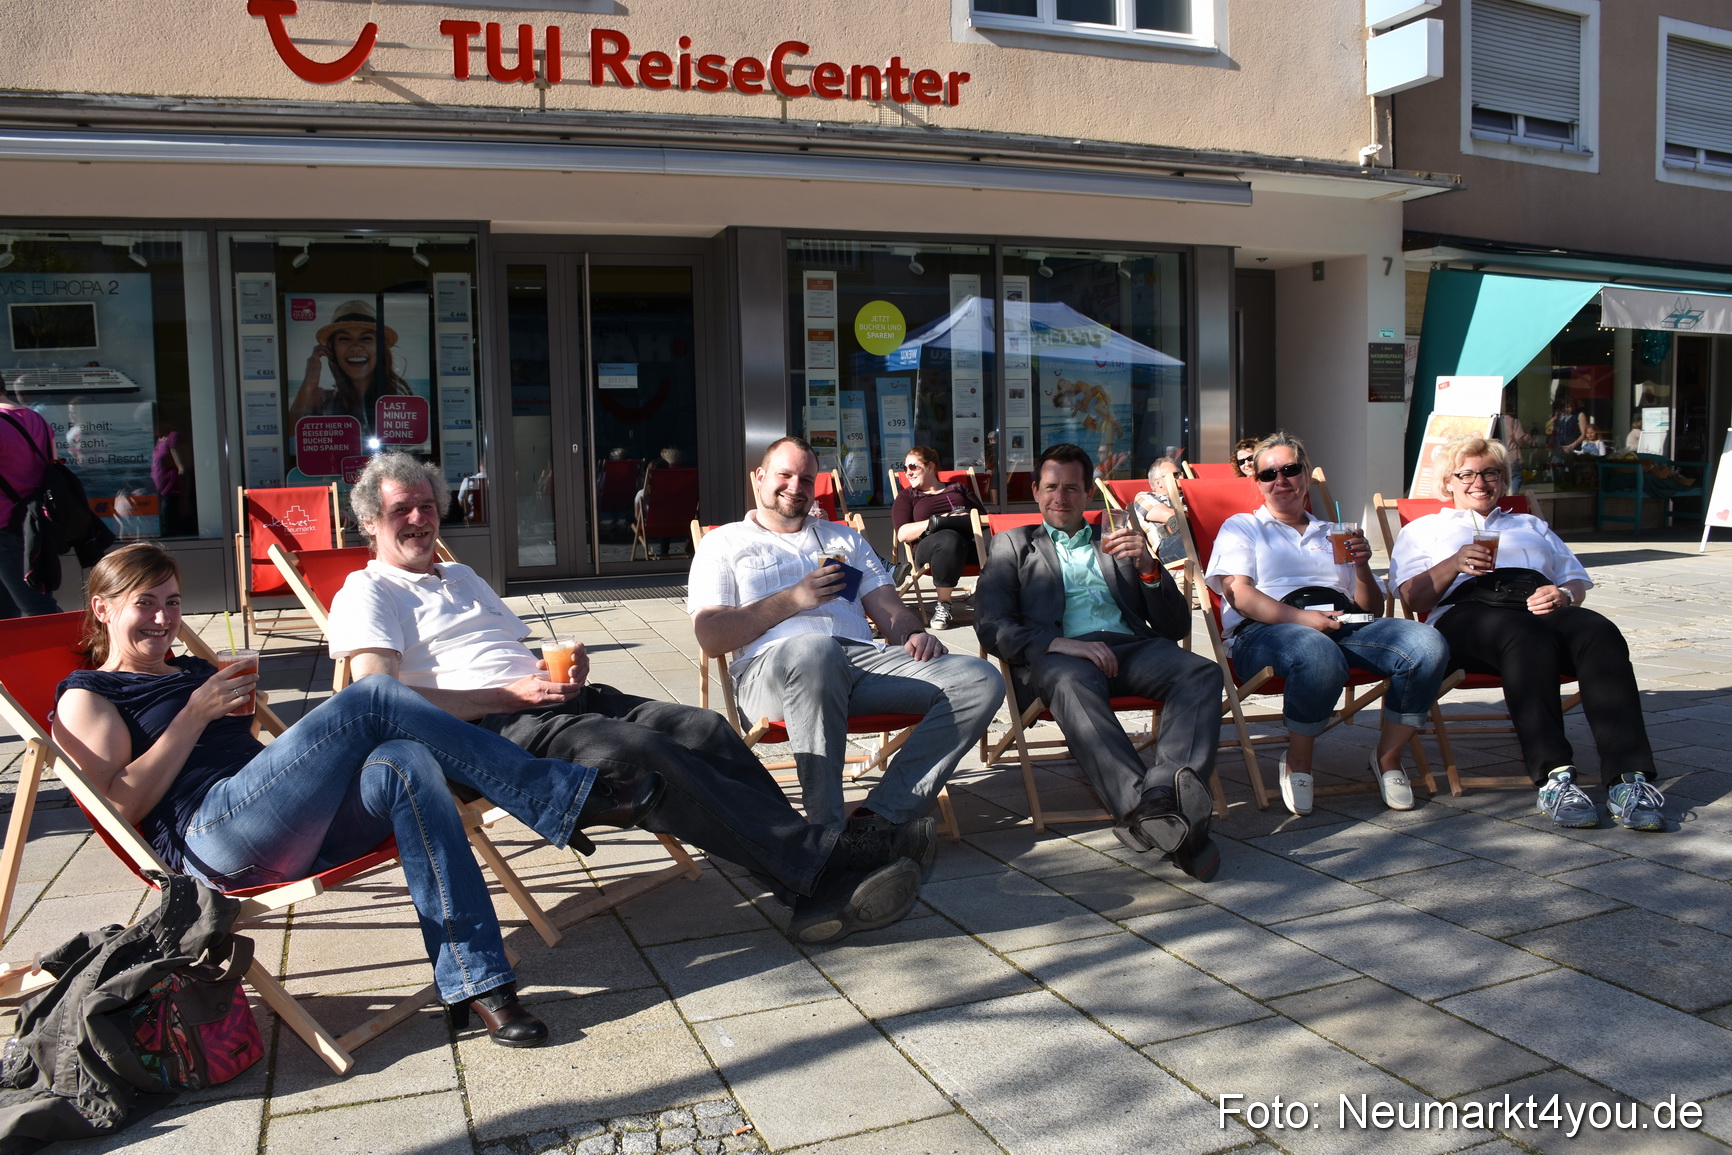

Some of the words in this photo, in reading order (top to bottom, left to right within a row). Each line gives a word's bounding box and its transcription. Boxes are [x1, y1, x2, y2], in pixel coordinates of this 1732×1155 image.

[440, 20, 562, 84] TUI
[589, 29, 971, 106] ReiseCenter
[1382, 256, 1393, 276] 7
[32, 280, 104, 296] EUROPA
[108, 280, 119, 295] 2
[859, 323, 886, 331] BUCHEN
[383, 402, 407, 410] LAST
[383, 411, 418, 420] MINUTE
[68, 421, 113, 432] Feiheit:
[383, 421, 393, 429] IN
[395, 421, 410, 429] DIE
[302, 429, 344, 437] REISEBÜRO
[383, 430, 414, 439] SONNE
[88, 454, 104, 465] ein
[108, 454, 148, 464] Resort.
[284, 525, 316, 533] Neumarkt
